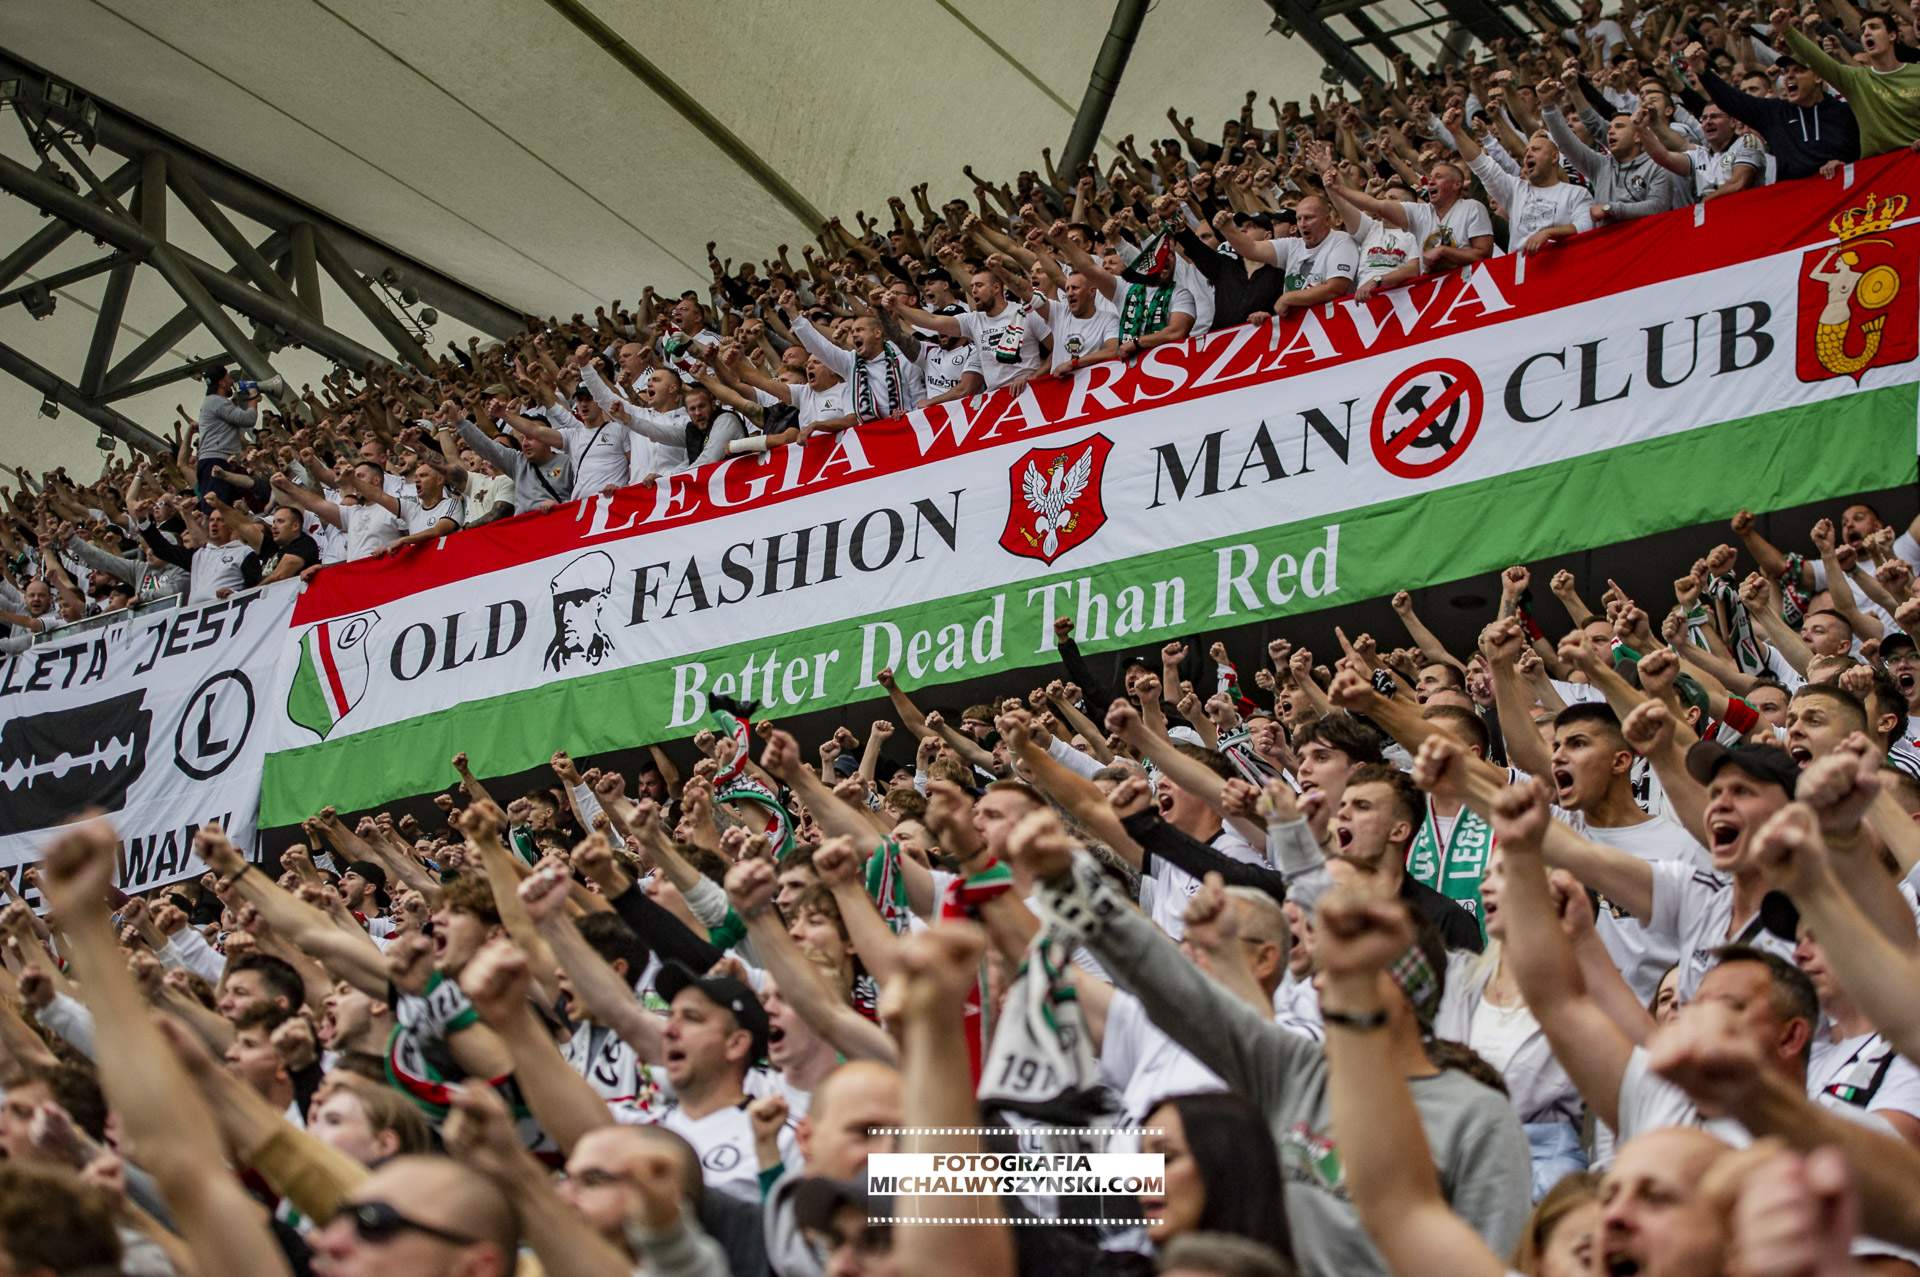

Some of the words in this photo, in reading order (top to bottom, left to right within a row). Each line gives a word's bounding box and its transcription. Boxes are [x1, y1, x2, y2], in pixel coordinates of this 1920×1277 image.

[389, 600, 527, 681] OLD
[624, 488, 967, 627] FASHION
[1145, 398, 1360, 509] MAN
[1503, 300, 1775, 424] CLUB
[580, 431, 875, 539] LEGIA
[903, 261, 1516, 457] WARSZAWA
[0, 625, 123, 697] LETA"
[133, 590, 262, 677] JEST
[665, 648, 839, 729] Better
[853, 593, 1006, 690] Dead
[1026, 575, 1186, 653] Than
[1208, 524, 1340, 618] Red
